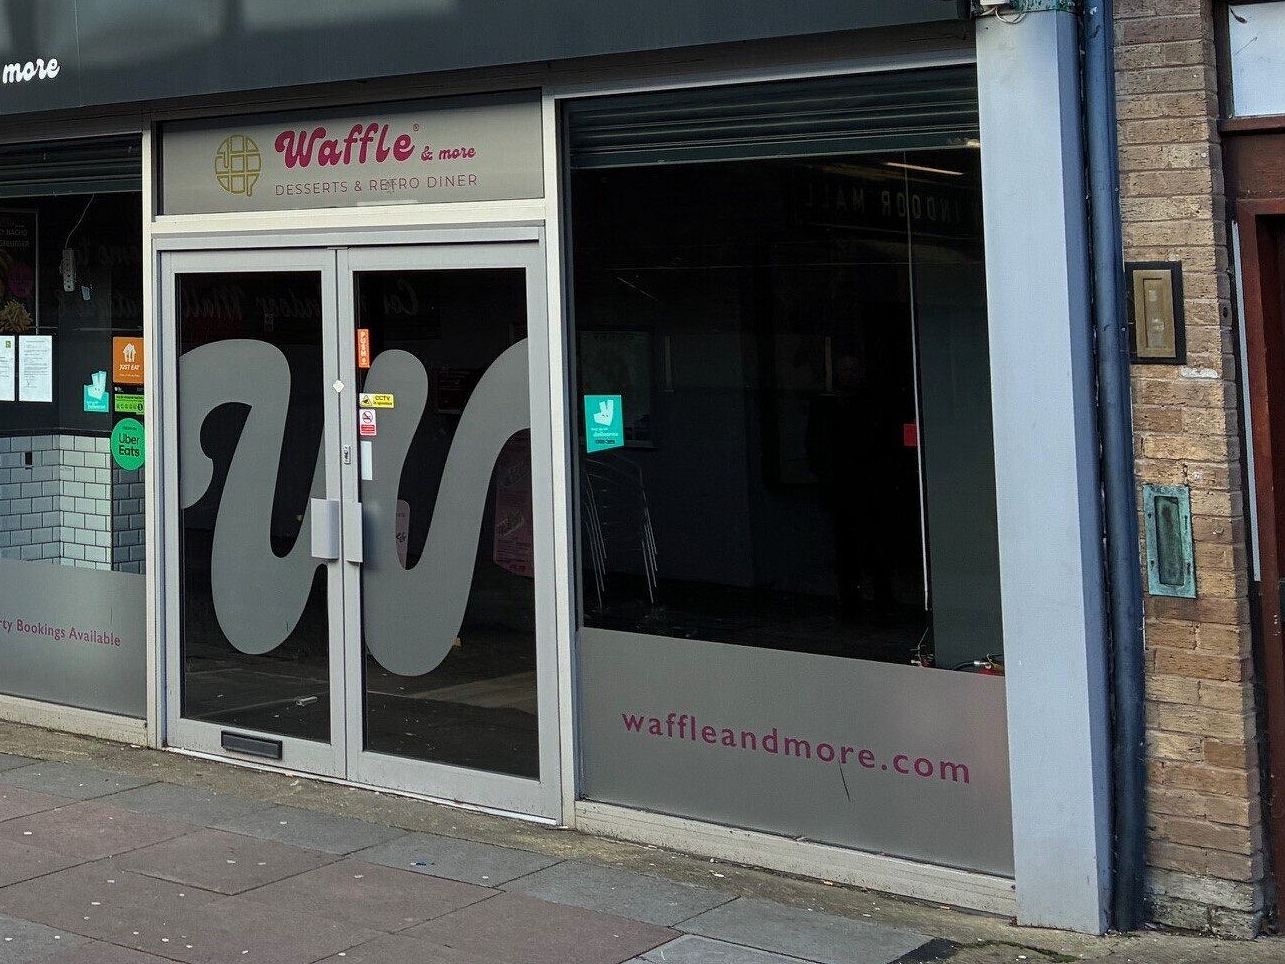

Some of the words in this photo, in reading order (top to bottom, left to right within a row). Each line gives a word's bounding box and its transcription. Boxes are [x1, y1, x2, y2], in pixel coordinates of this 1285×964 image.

[2, 57, 60, 85] more
[274, 122, 416, 169] Waffle
[420, 145, 433, 161] &
[438, 146, 477, 160] more
[276, 181, 348, 196] DESSERTS
[354, 181, 363, 192] &
[370, 177, 420, 192] RETRO
[427, 174, 478, 188] DINER
[118, 432, 140, 445] Uber
[118, 445, 140, 458] Eats
[17, 619, 66, 641] Bookings
[68, 627, 121, 647] Available
[621, 712, 970, 784] waffleandmore.com
